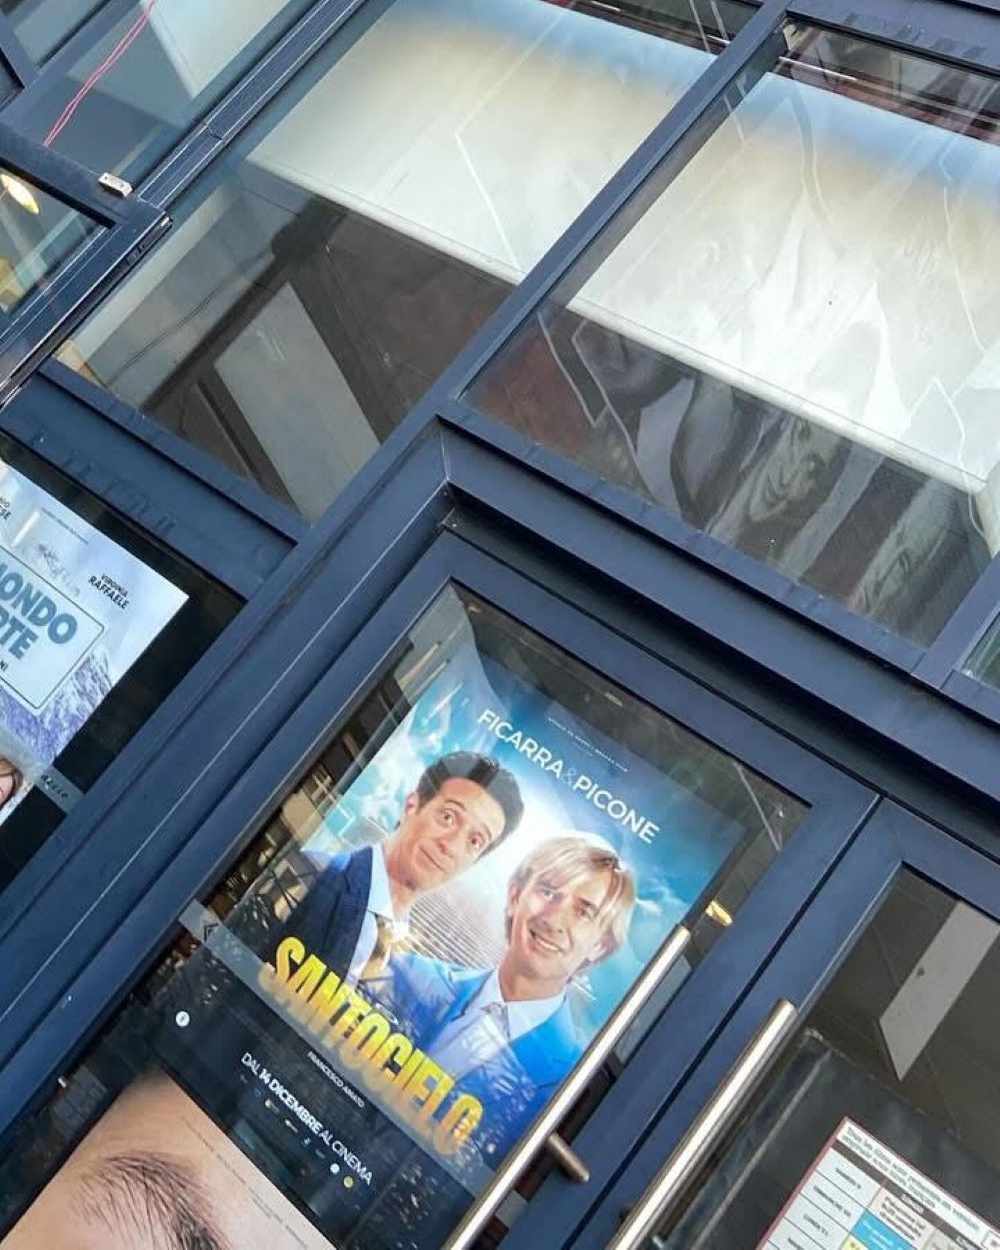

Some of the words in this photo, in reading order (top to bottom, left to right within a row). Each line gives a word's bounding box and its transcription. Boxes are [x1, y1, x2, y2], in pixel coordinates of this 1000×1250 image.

[88, 575, 130, 610] RAFFAELE
[475, 708, 567, 781] FICARRA
[571, 773, 661, 845] PICONE
[262, 936, 485, 1152] SANTOCIELO
[241, 1051, 261, 1077] DAL
[258, 1068, 272, 1085] 14
[268, 1078, 324, 1136] DICEMBRE
[319, 1129, 334, 1147] AL
[331, 1139, 373, 1187] CINEMA
